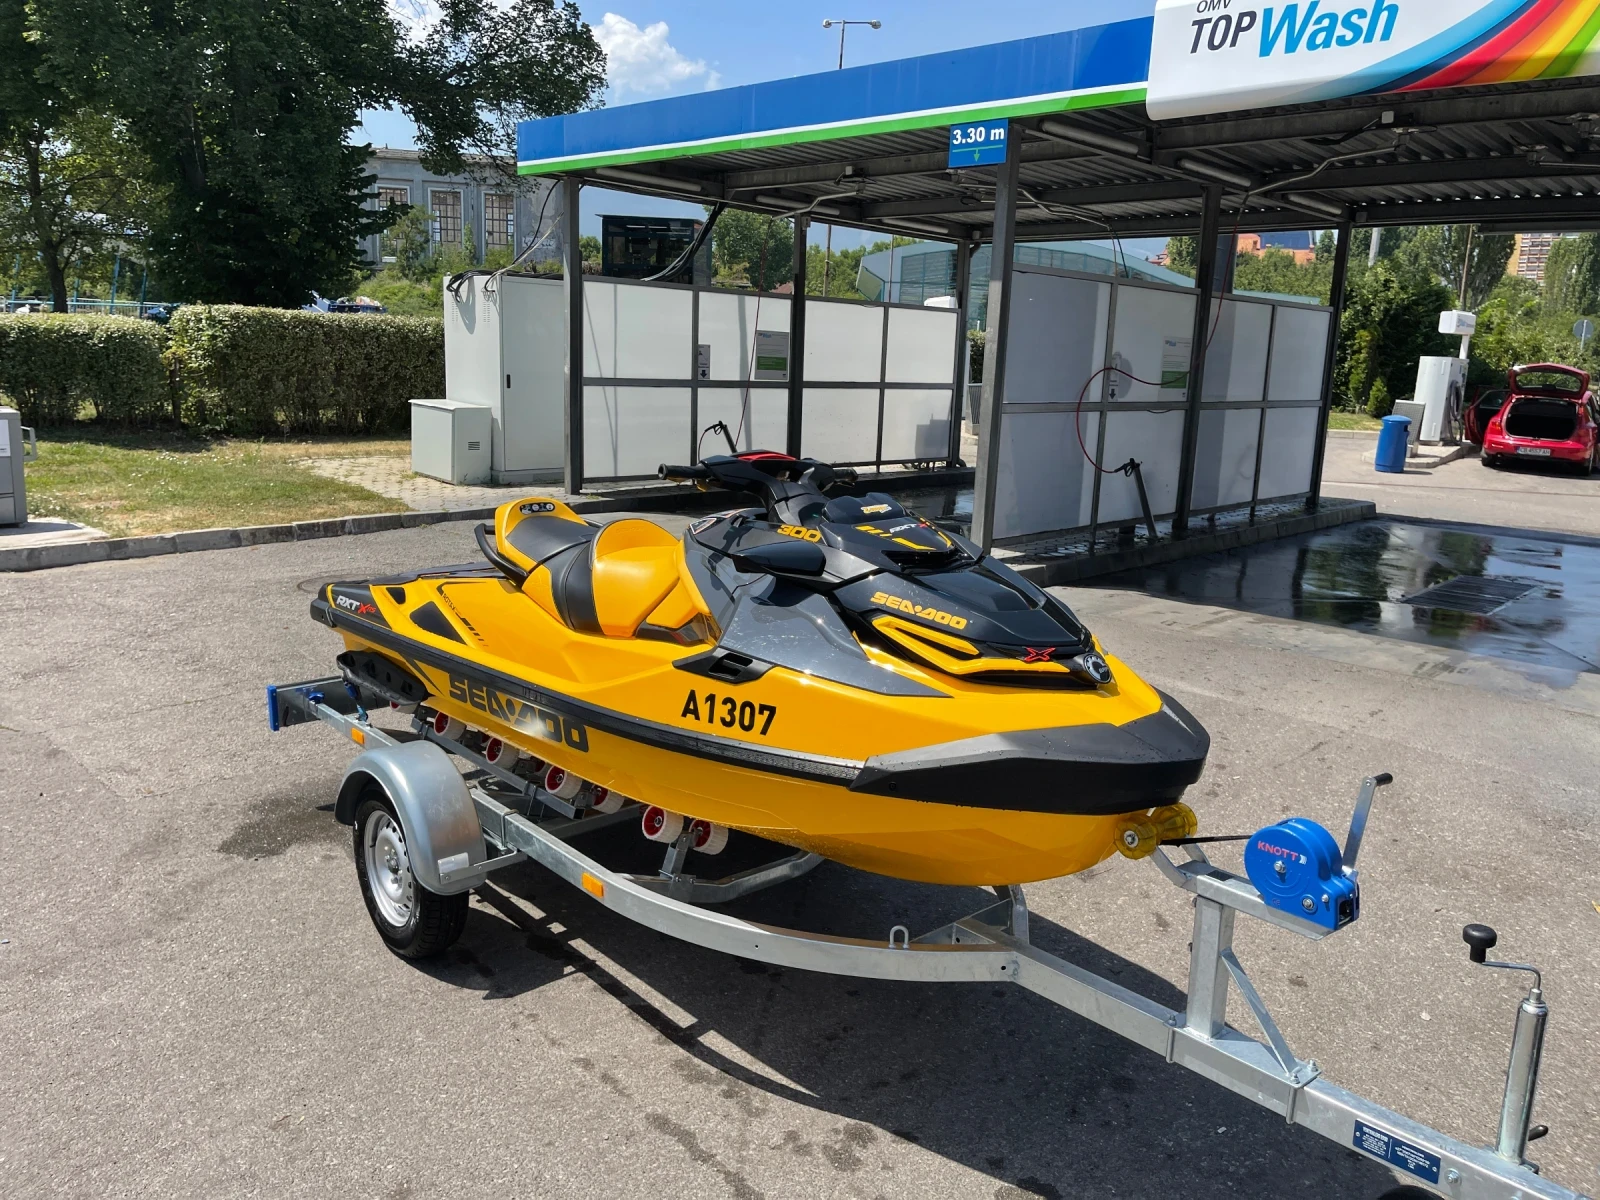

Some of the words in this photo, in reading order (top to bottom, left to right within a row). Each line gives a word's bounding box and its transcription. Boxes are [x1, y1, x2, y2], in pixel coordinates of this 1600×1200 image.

[1197, 0, 1231, 13] OMV
[953, 127, 985, 145] 3.30
[990, 128, 1004, 140] m
[777, 524, 821, 543] 300
[681, 689, 777, 736] A1307
[1257, 840, 1299, 861] KNOTT
